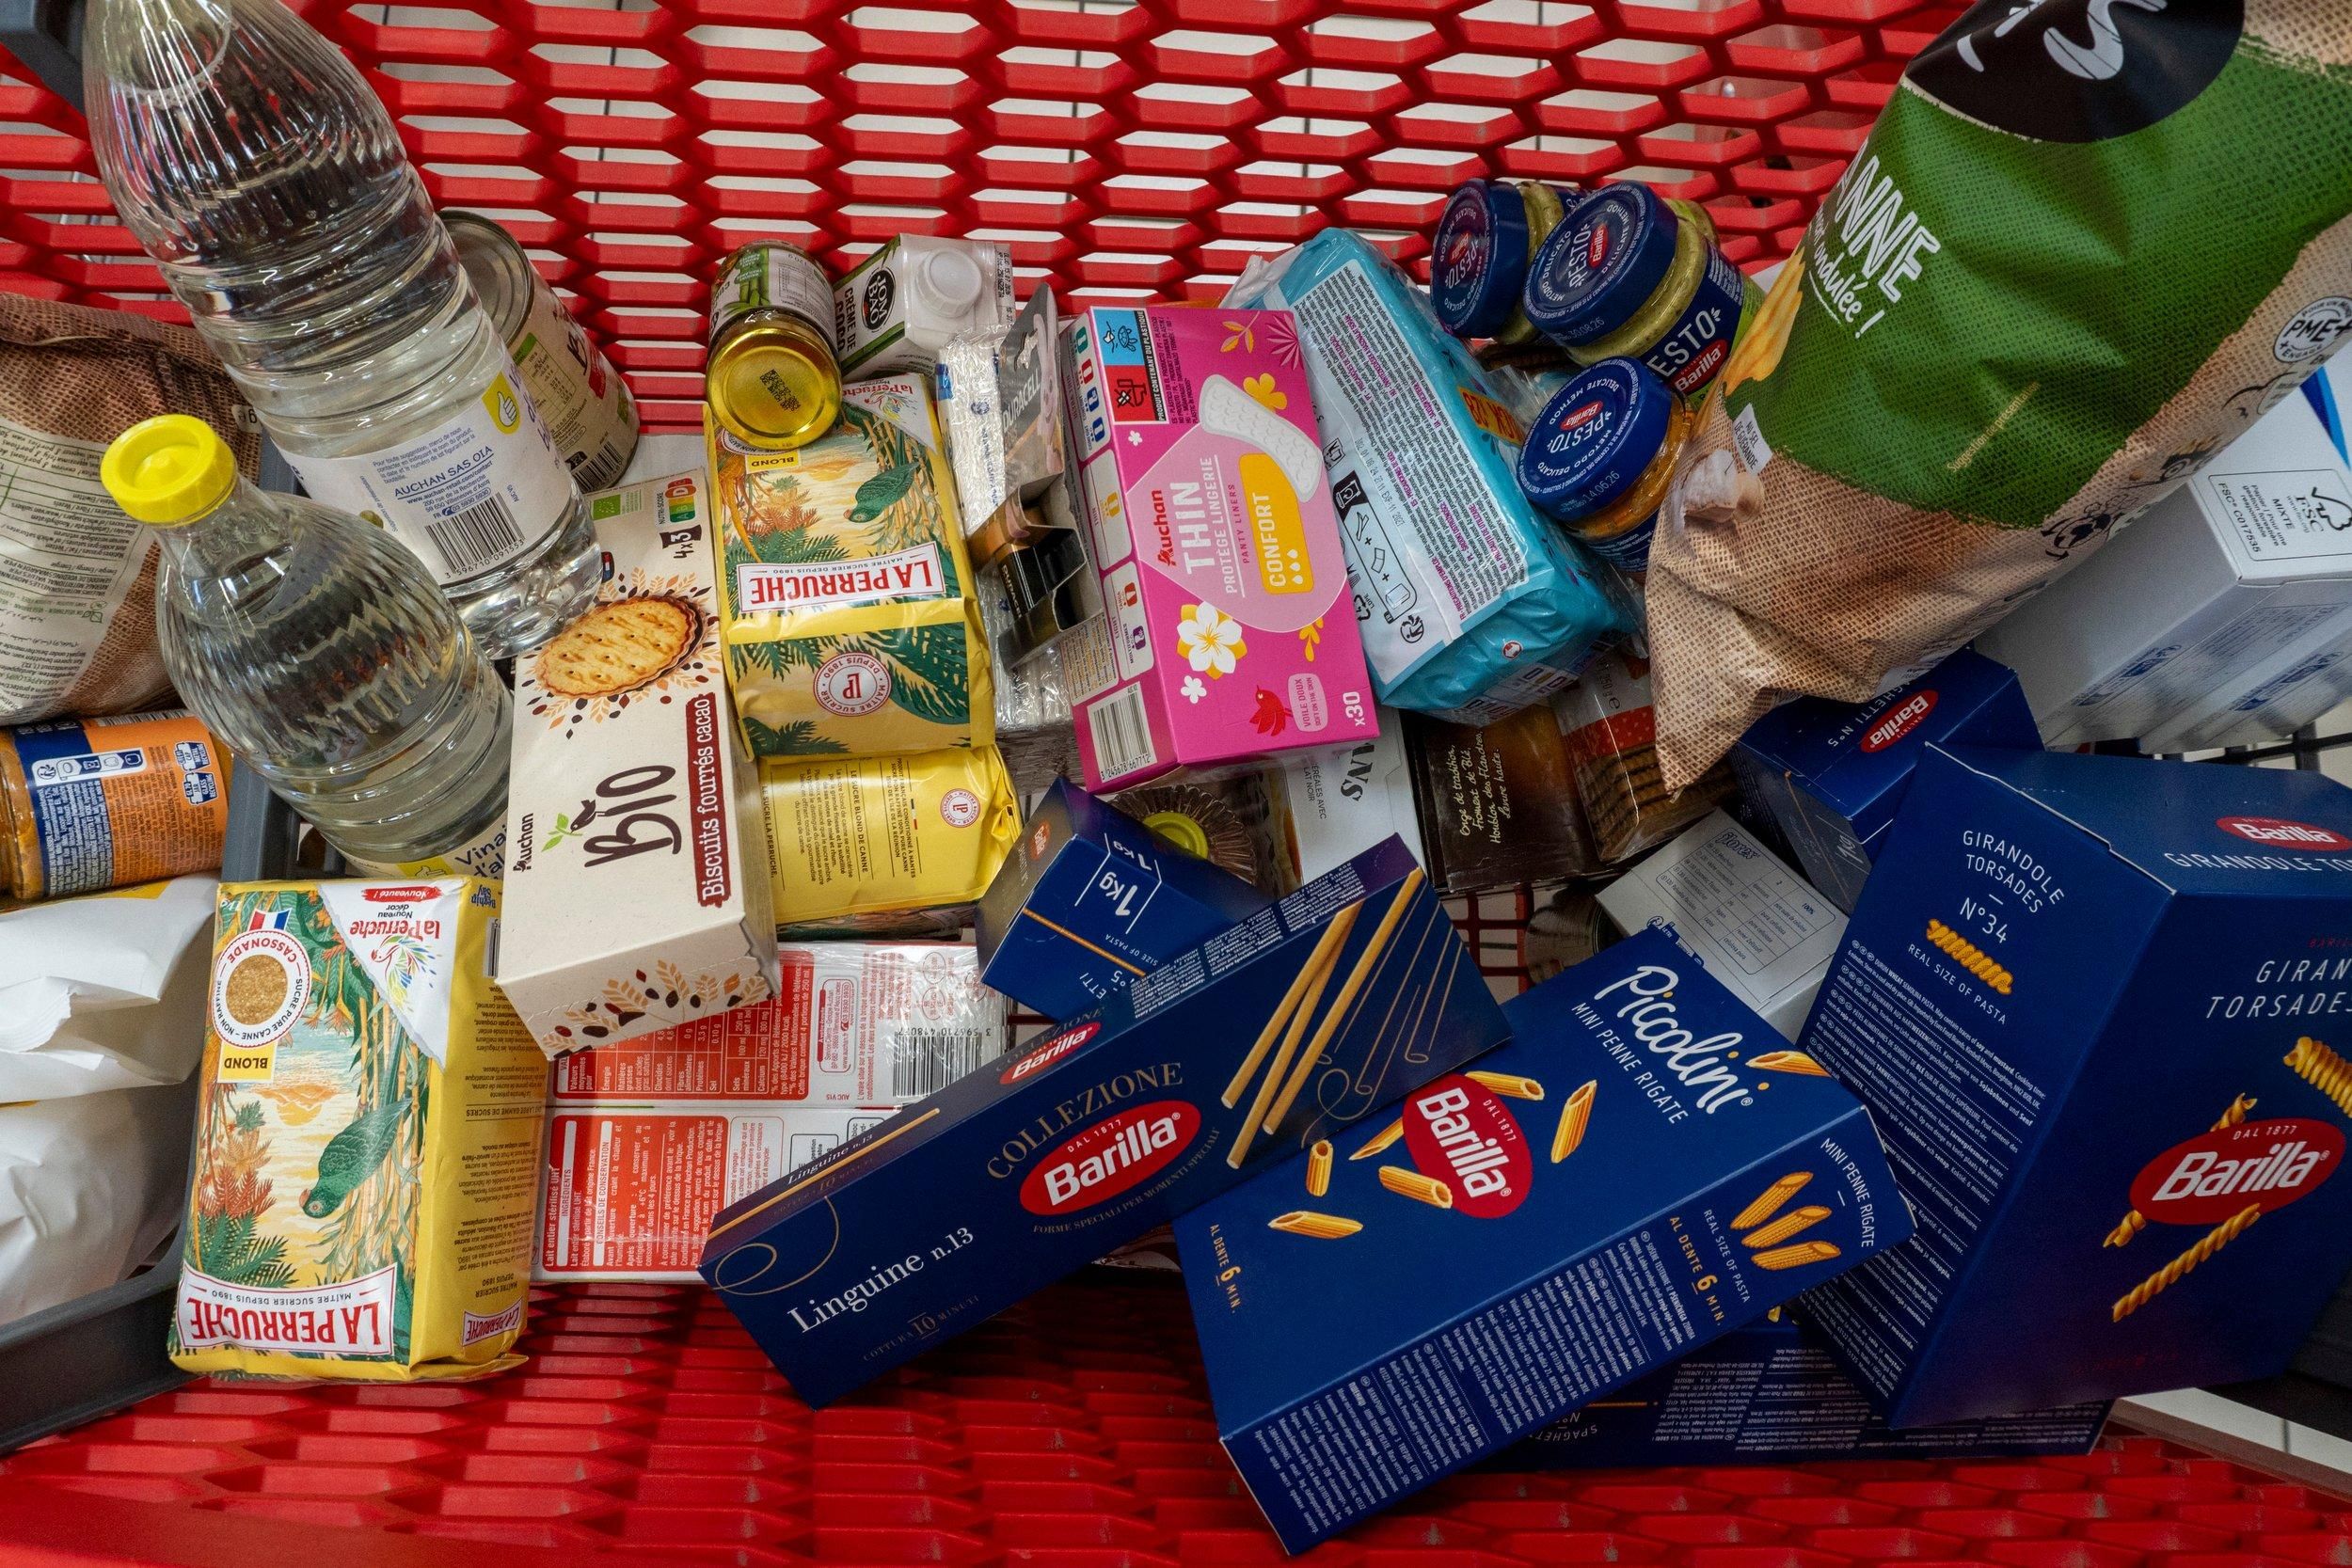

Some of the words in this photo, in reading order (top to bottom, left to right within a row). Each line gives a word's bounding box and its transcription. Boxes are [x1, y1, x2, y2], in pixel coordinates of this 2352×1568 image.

[1607, 204, 1629, 226] METHOD
[1543, 230, 1571, 278] DELICATO
[1567, 227, 1592, 288] PESTO
[1593, 229, 1604, 262] Barilla
[1601, 226, 1629, 275] DELICATE
[845, 286, 856, 327] CRÈME
[867, 283, 881, 328] BAO
[875, 279, 889, 320] JOM
[1542, 281, 1565, 302] METODO
[1136, 309, 1150, 344] PLASTIQUE
[1647, 309, 1716, 378] ESTO
[1146, 354, 1159, 392] CONTENANT
[1587, 379, 1620, 392] DELICATE
[1674, 345, 1722, 392] Barilla
[1002, 371, 1041, 431] DURACELL
[1153, 391, 1165, 421] PRODUIT
[1549, 388, 1584, 425] METHOD
[1565, 403, 1599, 426] Barilla
[1549, 415, 1606, 454] PESTO
[1574, 429, 1612, 468] METODO
[1737, 432, 1758, 469] GUÉRANDE
[1750, 432, 1758, 448] SEL
[394, 474, 447, 497] AUCHAN
[448, 460, 471, 477] SAS
[472, 446, 493, 464] OIA
[751, 456, 795, 467] BLOND
[1537, 462, 1569, 477] DELICATO
[1947, 435, 1991, 472] Suggestion
[1200, 456, 1223, 524] LINGERIE
[1228, 484, 1242, 523] LINERS
[1152, 489, 1176, 566] Auchan
[1169, 481, 1216, 575] THIN
[2272, 498, 2296, 531] MIXTE
[1237, 530, 1249, 564] PANTY
[1252, 492, 1287, 588] CONFORT
[894, 560, 933, 588] LA
[1215, 528, 1237, 594] PROTÈGE
[750, 568, 890, 605] PERRUCHE
[824, 660, 843, 678] 1890
[846, 658, 880, 674] DEPUIS
[1294, 678, 1304, 697] DOUX
[695, 698, 714, 744] cacao
[1296, 698, 1311, 727] VOILE
[1343, 690, 1366, 727] x30
[1869, 695, 1930, 746] Barilla
[1446, 745, 1462, 790] tradition,
[1475, 731, 1490, 780] Flandres,
[695, 740, 719, 812] fourrés
[853, 806, 864, 832] BLOND
[1317, 799, 1327, 820] AVEC
[1459, 808, 1472, 836] Orge
[1470, 788, 1485, 832] Froment
[1487, 802, 1502, 844] Houblon
[513, 813, 534, 872] Auchan
[857, 833, 865, 844] DE
[2232, 822, 2339, 845] Barilla
[699, 811, 725, 901] Biscuits
[858, 846, 868, 873] CANNE
[1962, 830, 2065, 906] GIRANDOLE
[2164, 852, 2324, 872] GIRANDOLE
[379, 888, 428, 900] Nouveauté
[471, 895, 497, 909] Beghin
[478, 884, 492, 896] Say
[1099, 870, 1138, 917] 1kg
[1965, 853, 2044, 914] TORSADES
[377, 911, 413, 919] Nouveau
[1959, 896, 2009, 944] N°34
[229, 937, 297, 964] CASSONADE
[290, 978, 303, 1011] SUCRE
[1908, 942, 1931, 967] REAL
[1933, 964, 1955, 986] SIZE
[1958, 982, 1972, 997] OF
[1973, 994, 2008, 1025] PASTA
[220, 1019, 234, 1035] NON
[242, 1028, 271, 1040] CANNE
[271, 1011, 293, 1033] PURE
[1594, 965, 1771, 1115] Picolini
[224, 1057, 268, 1069] BLOND
[1012, 1026, 1090, 1079] Barilla
[1571, 1002, 1602, 1031] MINI
[1597, 1030, 1642, 1072] PENNE
[1633, 1070, 1690, 1125] RIGATE
[757, 1066, 766, 1092] Calcium
[986, 1060, 1185, 1180] COLLEZIONE
[1978, 1081, 2010, 1109] Sojabohnen
[2019, 1112, 2034, 1128] Senf
[1067, 1134, 1092, 1154] DAL
[1094, 1117, 1123, 1139] 1877
[1416, 1086, 1510, 1198] Barilla
[2233, 1128, 2259, 1141] DAL
[2266, 1125, 2298, 1136] 1877
[550, 1167, 561, 1184] UHT
[598, 1141, 610, 1196] CONSERVATION
[1043, 1116, 1177, 1207] Barilla
[1073, 1205, 1120, 1232] SPECIALI
[1143, 1165, 1190, 1204] MOMENTI
[1187, 1126, 1222, 1172] SPECIALI
[2152, 1140, 2319, 1201] Barilla
[548, 1185, 559, 1221] stérilisé
[1820, 1136, 1849, 1165] MINI
[1842, 1162, 1870, 1200] PENNE
[1859, 1203, 1875, 1248] RIGATE
[548, 1222, 556, 1251] entier
[596, 1207, 605, 1244] CONSEILS
[545, 1252, 553, 1267] Lait
[1669, 1214, 1683, 1232] AL
[1677, 1233, 1703, 1274] DENTE
[1694, 1272, 1720, 1291] 6
[1703, 1209, 1720, 1235] REAL
[1714, 1234, 1731, 1258] SIZE
[1724, 1258, 1738, 1272] OF
[1731, 1272, 1751, 1304] PASTA
[212, 1290, 230, 1300] 1890
[318, 1292, 351, 1305] MAÎTRE
[786, 1247, 926, 1334] Linguine
[930, 1226, 977, 1264] n.13
[233, 1295, 270, 1306] DEPUIS
[272, 1296, 316, 1307] SUCRIER
[186, 1297, 336, 1345] PERRUCHE
[340, 1301, 382, 1346] LA
[862, 1331, 914, 1362] COTTURA
